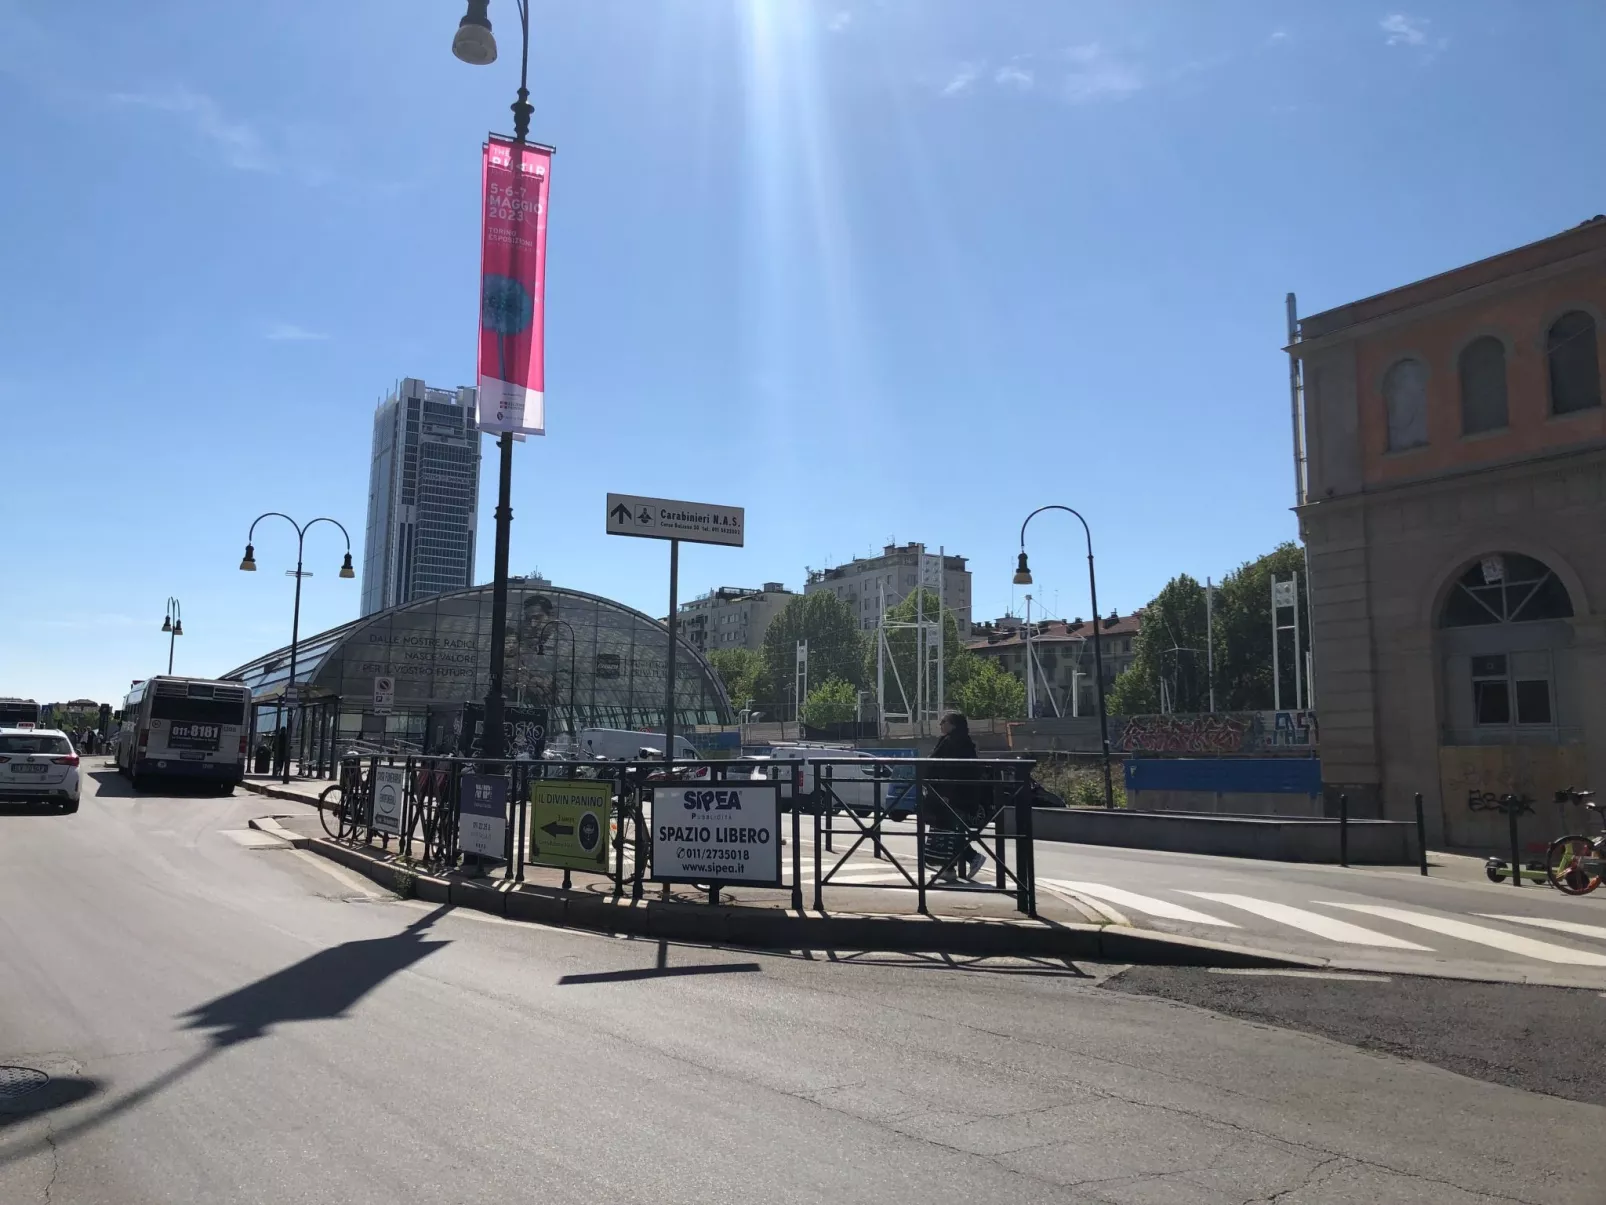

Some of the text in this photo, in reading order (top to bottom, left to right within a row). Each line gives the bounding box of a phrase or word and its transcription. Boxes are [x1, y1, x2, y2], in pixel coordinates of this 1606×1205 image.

[494, 147, 510, 157] THE
[490, 183, 526, 198] 5-6-7
[489, 195, 542, 215] MAGGIO
[489, 207, 524, 221] 2023
[488, 227, 517, 236] TORINO
[488, 233, 533, 247] ESPOSIZIONI
[660, 508, 741, 528] Carabinieri N.A.S.
[369, 634, 400, 644] DALLE
[402, 636, 441, 647] NOSTRE
[404, 652, 477, 664] NASCE VALORE
[362, 663, 381, 673] PER
[393, 664, 434, 676] VOSTRO
[538, 793, 604, 808] IL DIVIN PANINO
[683, 790, 742, 812] SIPEA
[659, 826, 770, 844] SPAZIO LIBERO
[686, 848, 750, 861] 011/2735018
[682, 861, 745, 875] www.sipea.it
